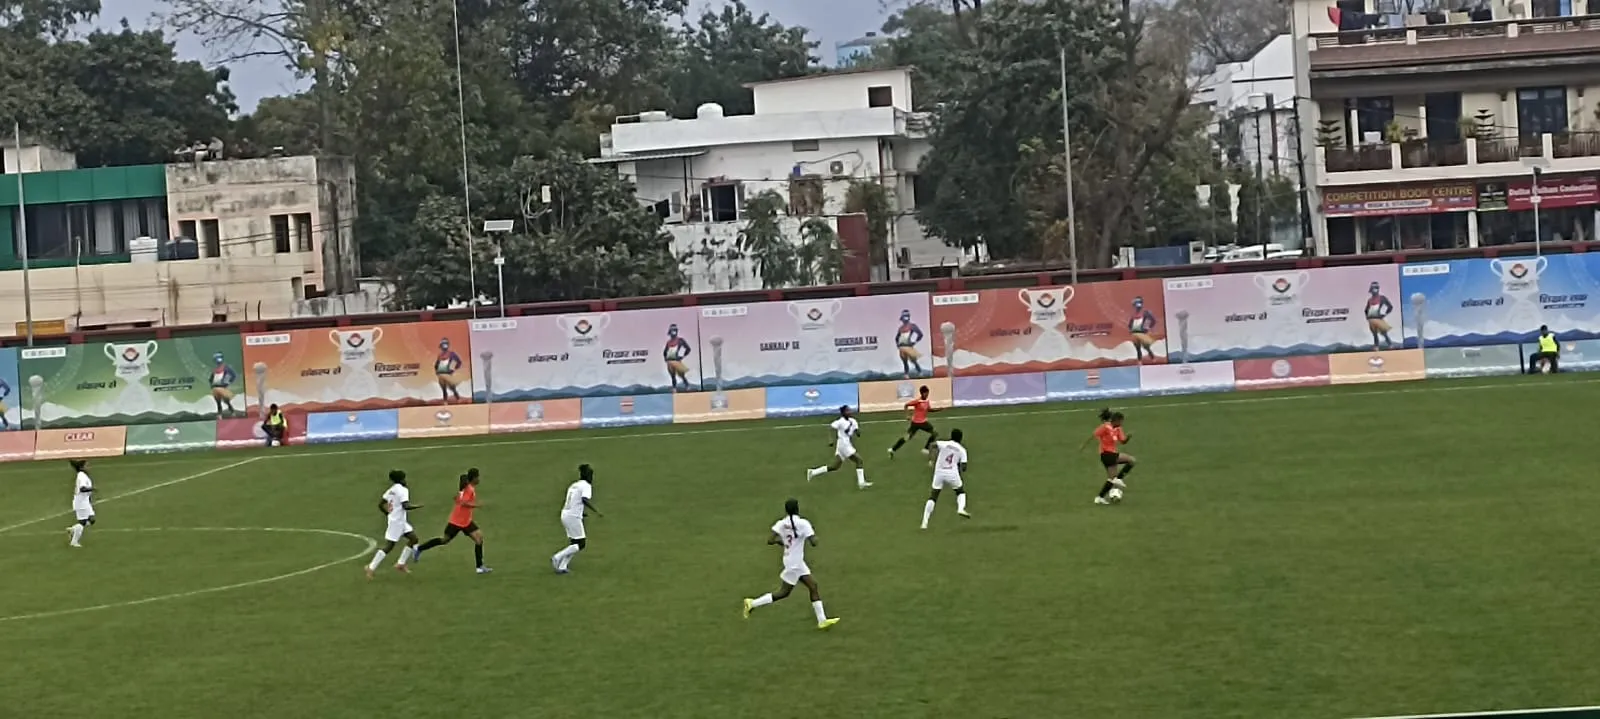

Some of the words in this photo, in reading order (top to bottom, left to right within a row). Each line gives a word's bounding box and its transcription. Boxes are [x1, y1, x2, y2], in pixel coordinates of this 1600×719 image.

[1326, 191, 1396, 202] COMPETITION
[1399, 188, 1429, 198] BOOK
[1432, 186, 1473, 197] CENTRE
[65, 432, 94, 441] CLEAR
[945, 453, 954, 465] 4
